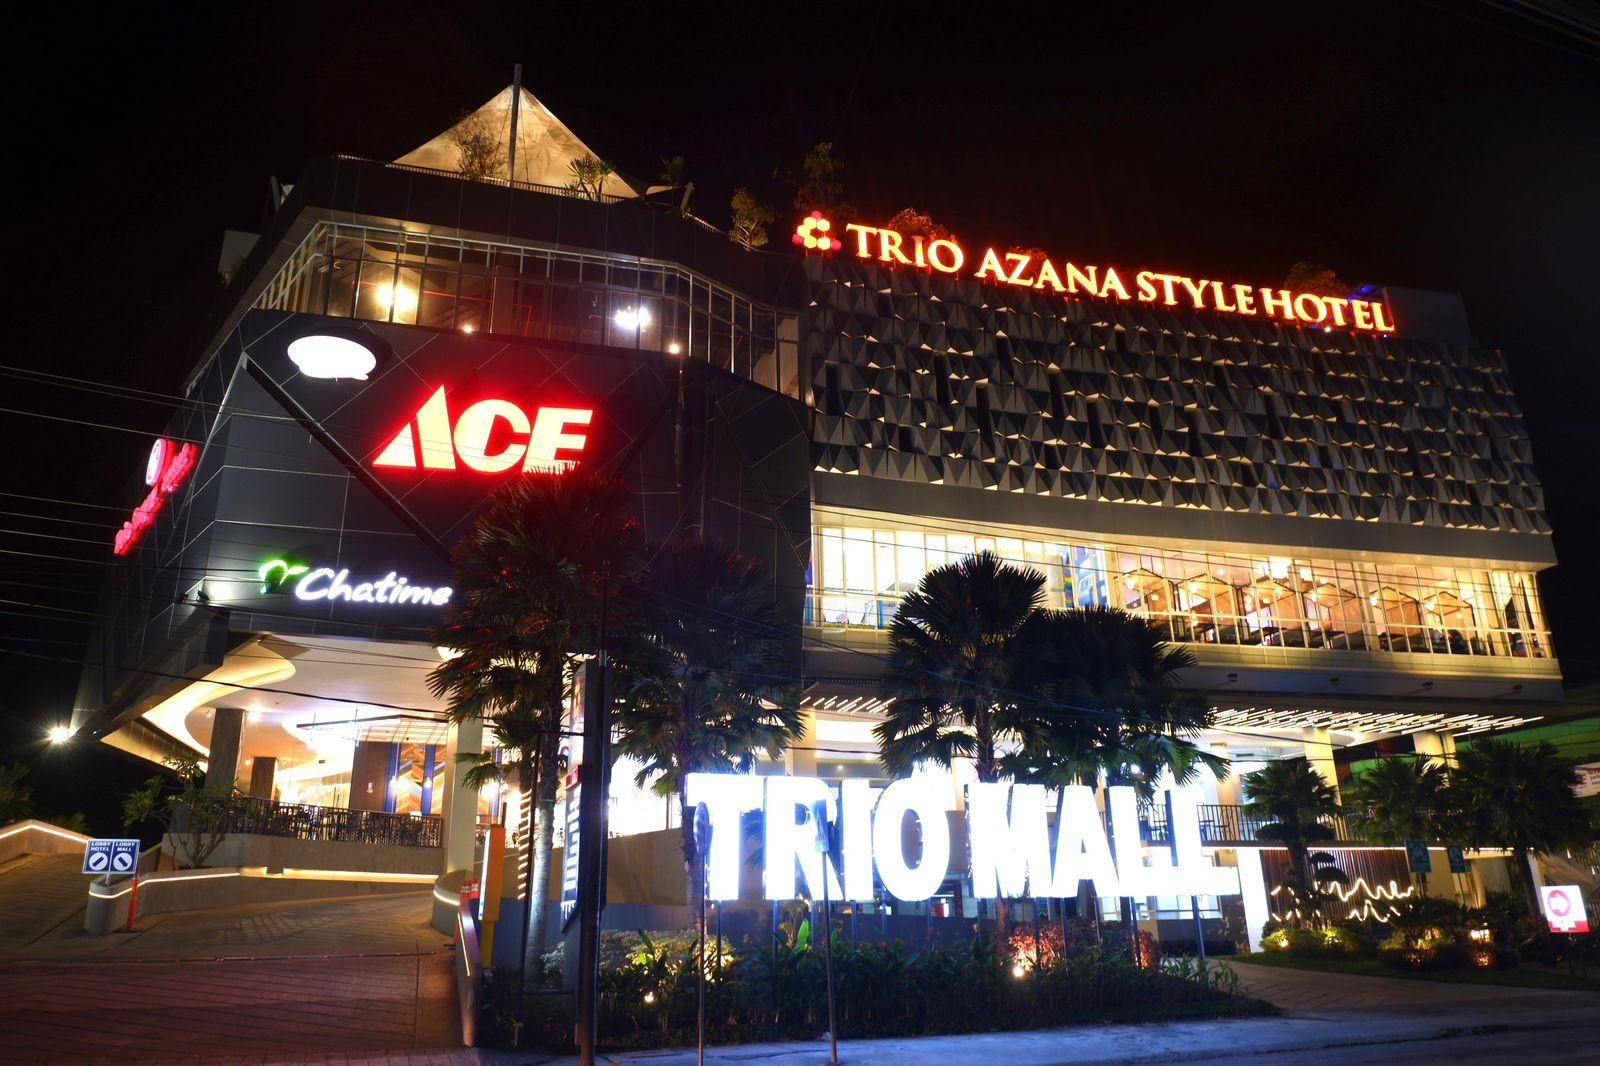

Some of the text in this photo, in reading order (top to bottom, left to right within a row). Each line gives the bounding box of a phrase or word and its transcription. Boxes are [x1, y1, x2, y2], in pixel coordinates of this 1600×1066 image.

[846, 223, 1395, 333] TRIO AZANA STYLE HOTEL
[372, 384, 594, 475] ACE
[295, 566, 453, 606] Chatime
[685, 772, 953, 902] TRIO
[967, 780, 1240, 899] MALL
